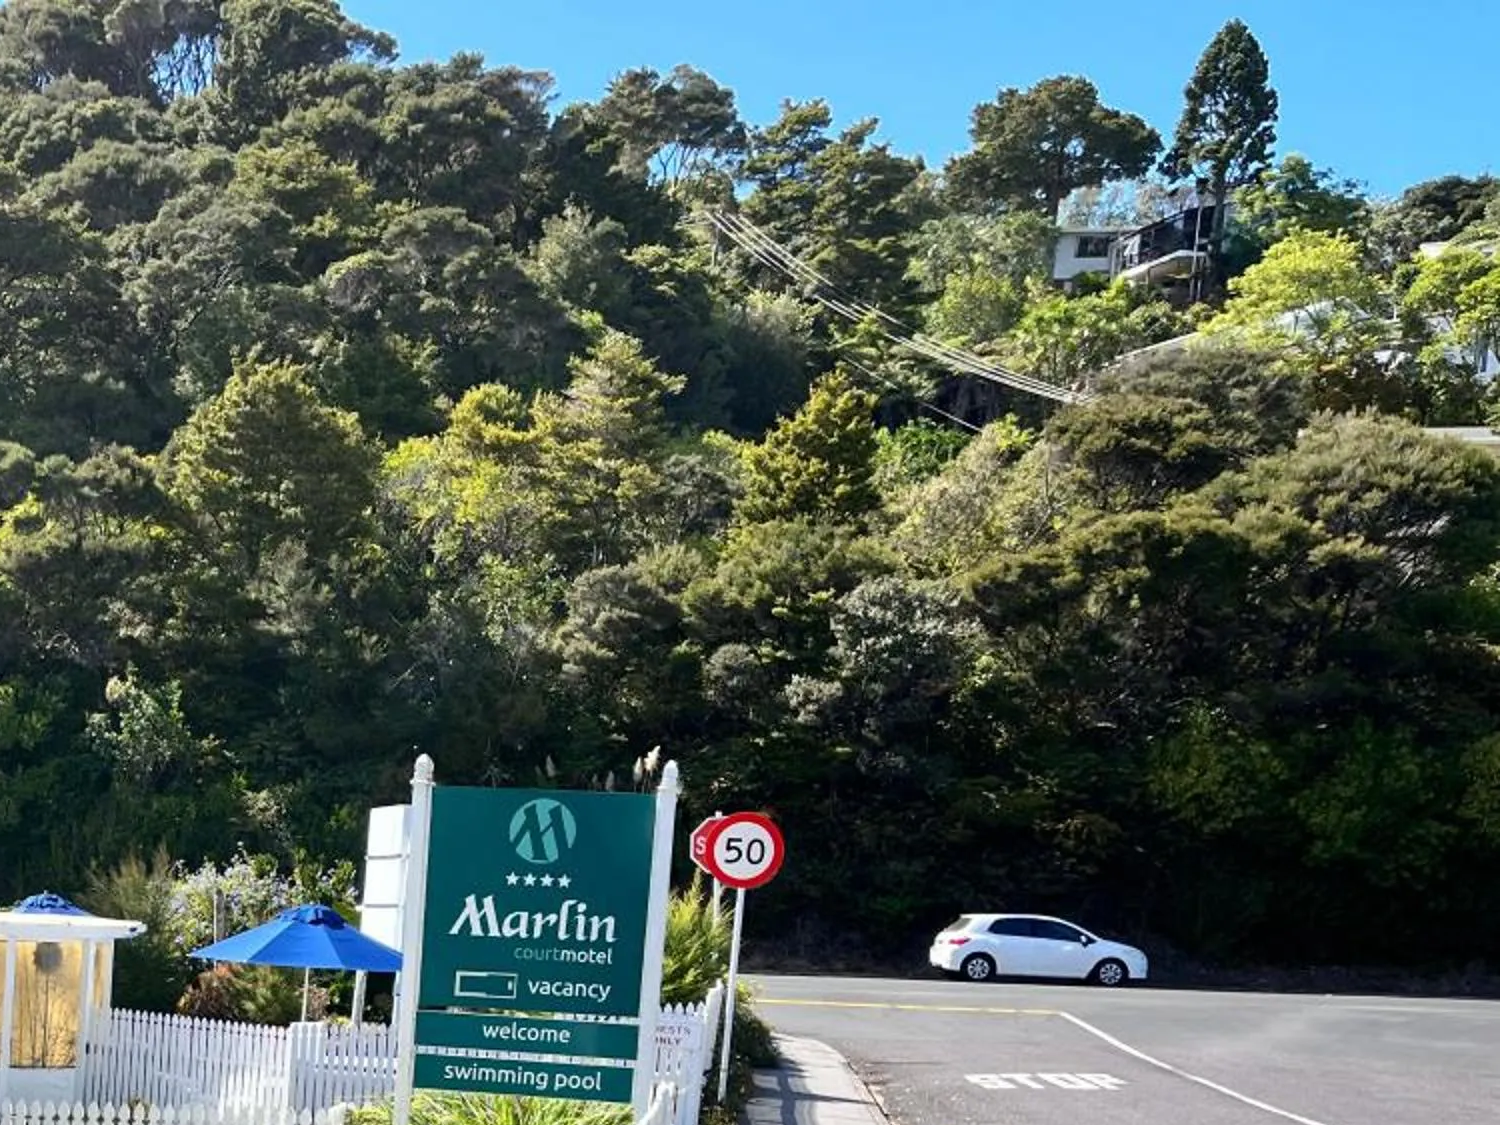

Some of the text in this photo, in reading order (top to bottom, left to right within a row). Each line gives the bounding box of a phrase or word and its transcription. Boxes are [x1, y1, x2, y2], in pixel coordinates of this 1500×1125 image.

[724, 838, 765, 865] 50
[448, 893, 618, 942] Marlin
[514, 947, 612, 965] courtmotel
[527, 979, 611, 1001] vacancy
[483, 1021, 571, 1043] welcome
[444, 1063, 602, 1091] swimming pool
[964, 1072, 1128, 1090] STOP
